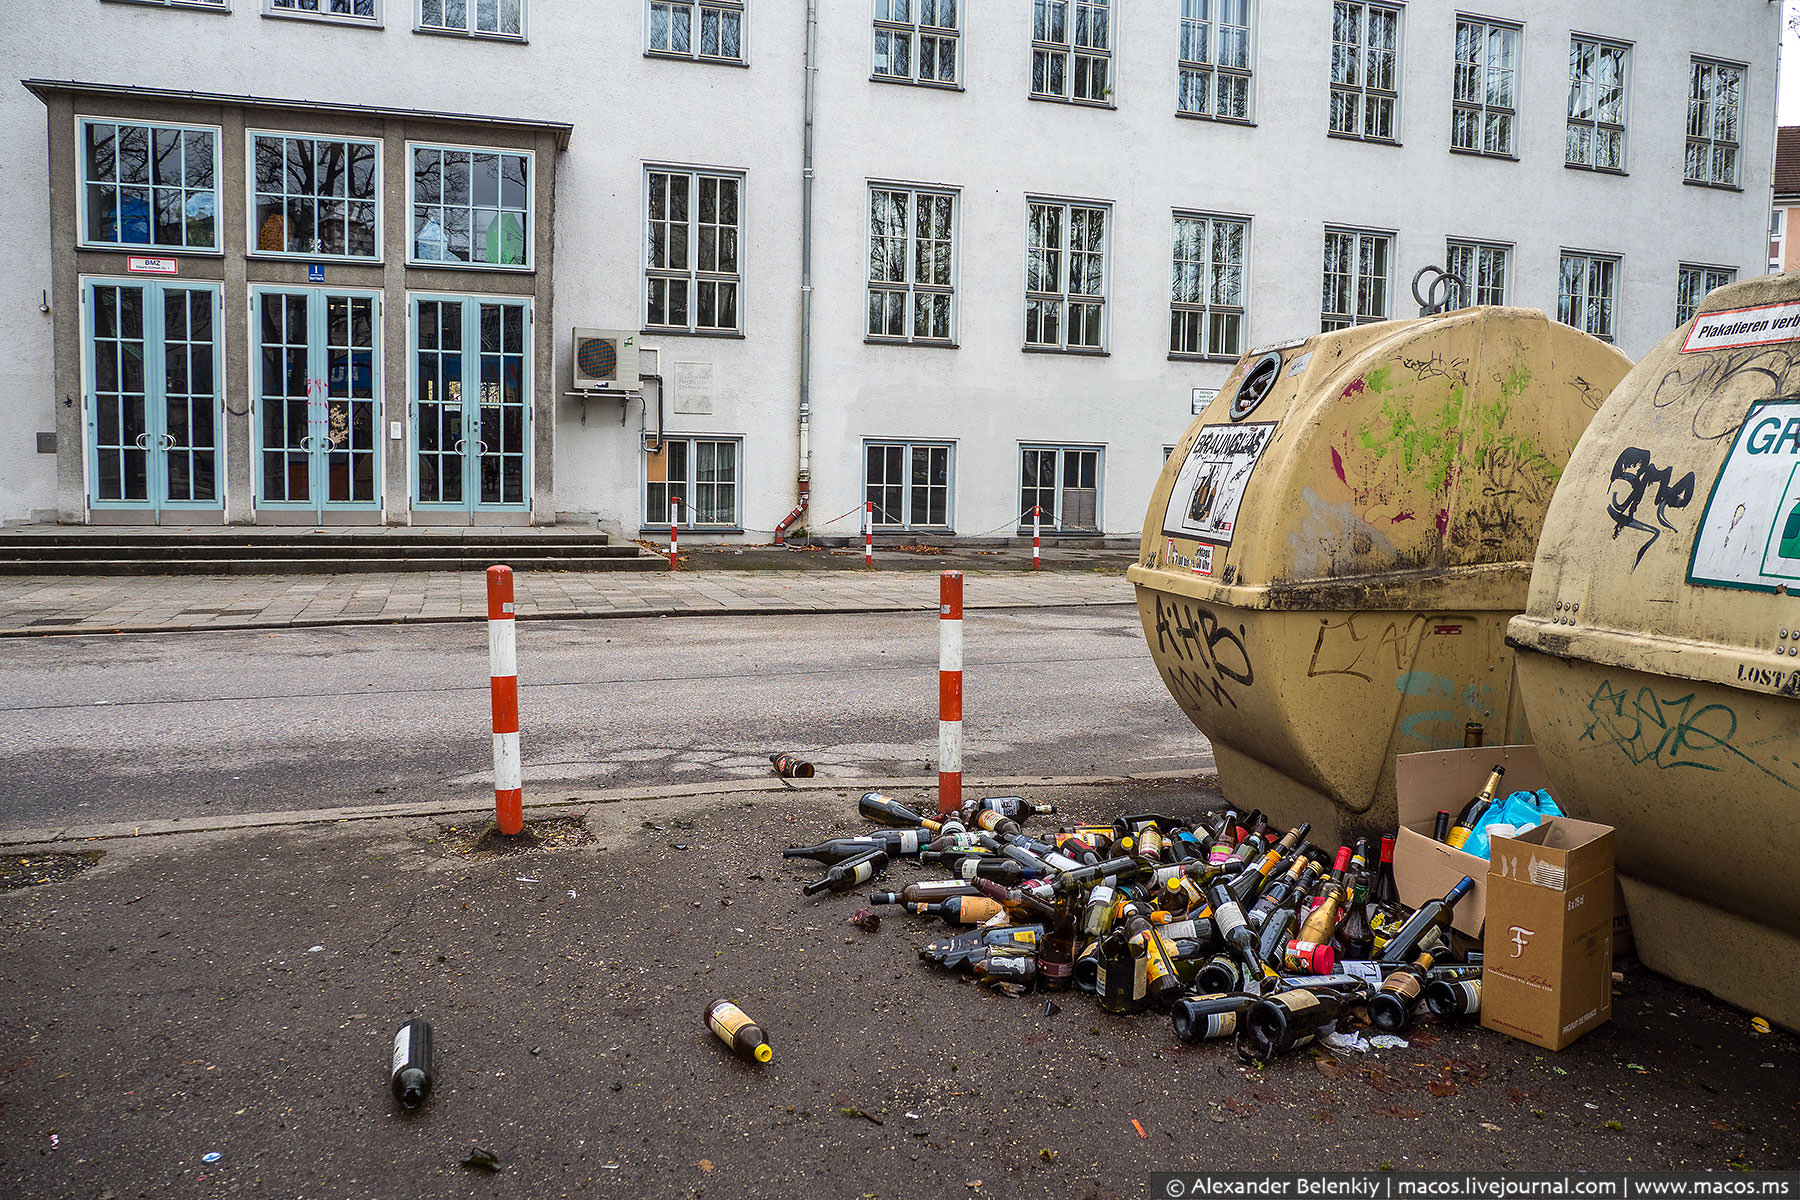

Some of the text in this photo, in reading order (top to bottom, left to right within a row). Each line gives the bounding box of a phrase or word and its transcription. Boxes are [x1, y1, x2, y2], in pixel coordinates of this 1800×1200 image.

[144, 259, 161, 267] BMZ
[1697, 319, 1760, 339] Plakatieren
[1192, 429, 1264, 455] BRAUNGLAS
[1736, 663, 1786, 689] LOST
